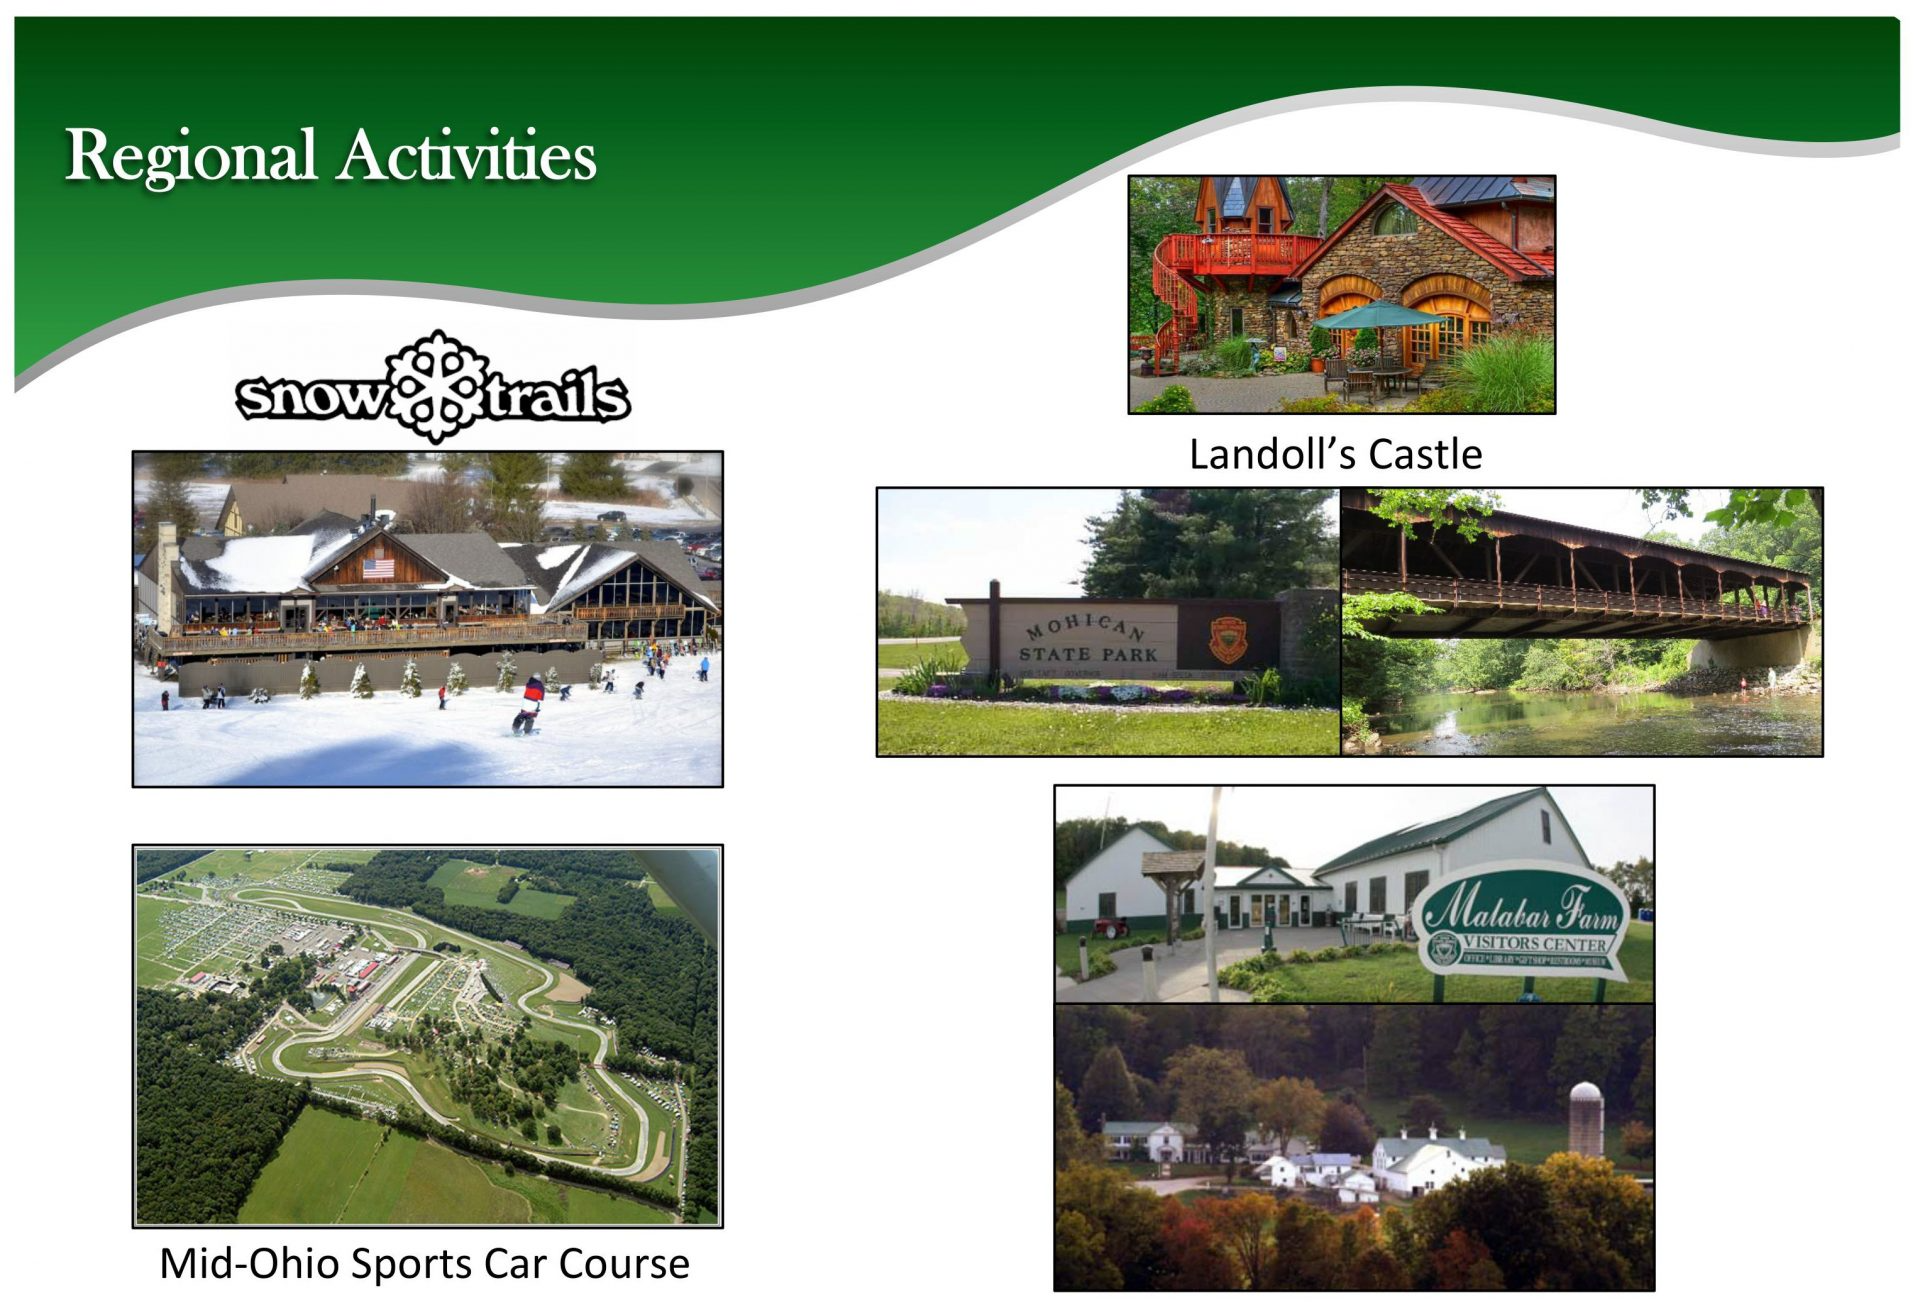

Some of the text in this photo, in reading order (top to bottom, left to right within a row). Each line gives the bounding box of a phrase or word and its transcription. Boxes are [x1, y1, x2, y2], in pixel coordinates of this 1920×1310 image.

[1026, 613, 1145, 642] MOHICAN
[1019, 647, 1158, 662] STATE PARK
[1425, 880, 1621, 930] Malabar Farm
[1464, 934, 1539, 950] VISITORS
[1543, 937, 1607, 952] CENTER
